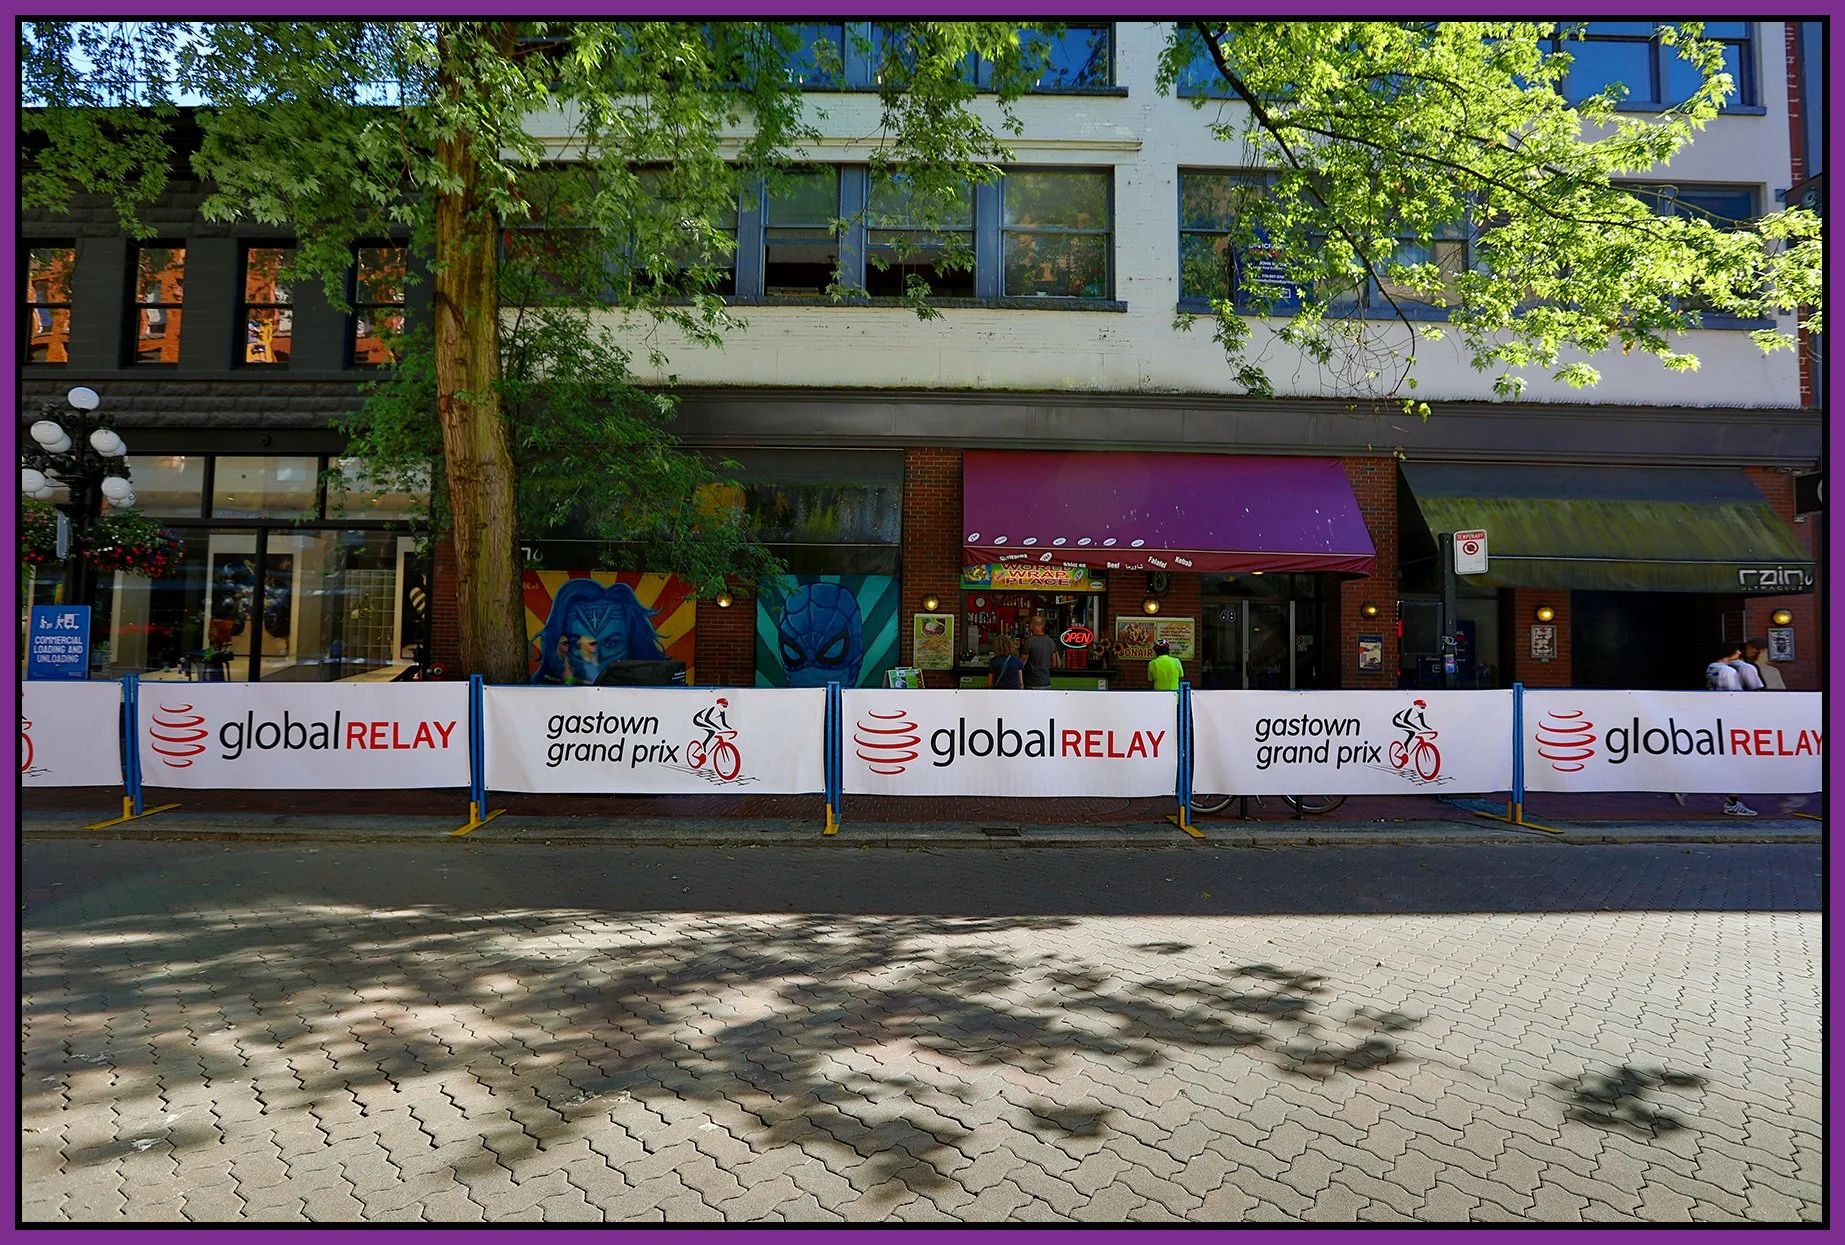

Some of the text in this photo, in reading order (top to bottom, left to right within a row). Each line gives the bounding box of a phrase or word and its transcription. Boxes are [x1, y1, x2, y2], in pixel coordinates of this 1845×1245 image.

[1001, 562, 1075, 572] WORLD
[1106, 561, 1121, 569] Beef
[1009, 570, 1068, 579] WRAP
[1004, 577, 1071, 587] PLACE
[1220, 610, 1237, 623] 68
[34, 636, 83, 645] COMMERCIAL
[1062, 632, 1090, 643] OPEN
[33, 645, 84, 654] LOADING AND
[1120, 648, 1153, 658] ONAIR
[36, 655, 80, 663] UNLOADING
[546, 711, 659, 739] gastown
[1255, 714, 1361, 742] gastown
[546, 737, 680, 768] grand prix
[1256, 739, 1382, 770] grand prix
